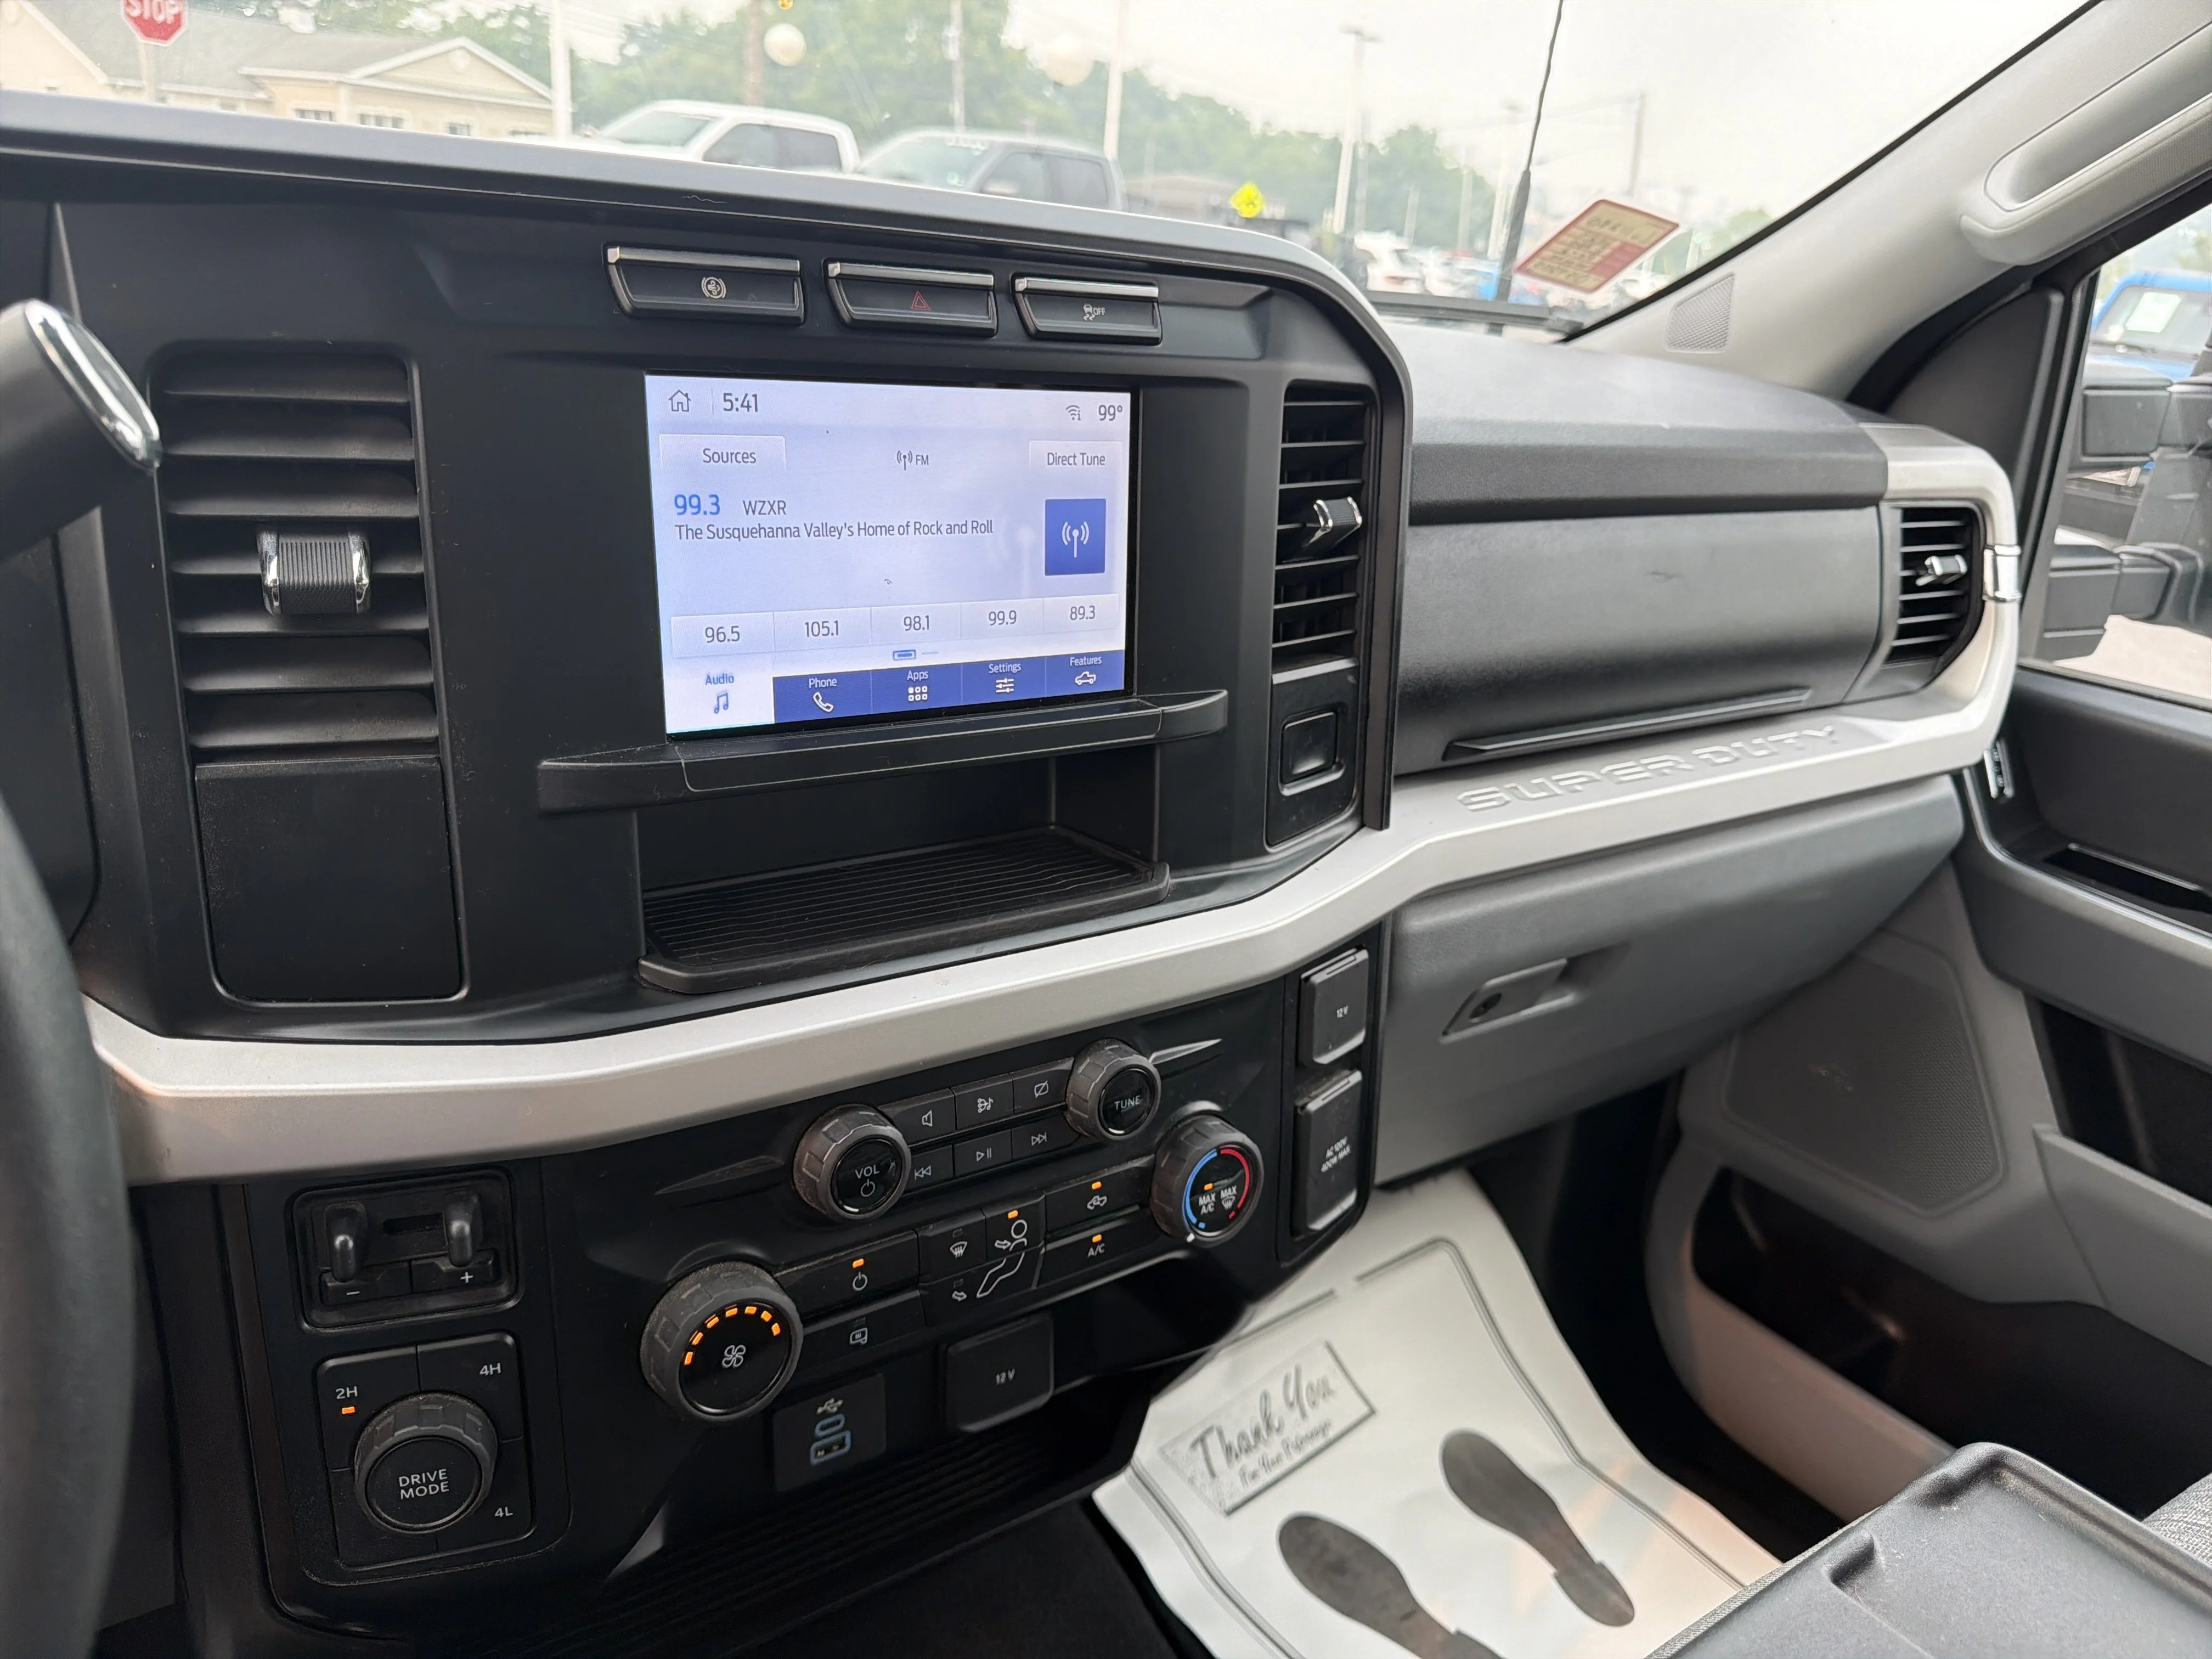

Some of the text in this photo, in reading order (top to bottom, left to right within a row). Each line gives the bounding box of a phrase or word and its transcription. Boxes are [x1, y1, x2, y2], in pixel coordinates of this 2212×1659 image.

[1093, 307, 1106, 316] OFF
[723, 392, 758, 412] 5:41
[702, 448, 757, 464] Sources
[916, 454, 929, 465] FM
[1047, 452, 1105, 466] Direct Tune
[674, 494, 787, 516] 99.3 WZXR
[675, 519, 994, 542] The Susquehanna Valley's Home of Rock and Roll
[988, 610, 1017, 627] 99.9
[1070, 605, 1096, 621] 89.3
[804, 620, 839, 637] 105.1
[904, 615, 930, 631] 98.1
[704, 625, 740, 644] 96.5
[988, 662, 1022, 674] Settings
[1069, 655, 1102, 667] Features
[705, 673, 735, 686] Audio
[907, 669, 929, 681] Apps
[809, 678, 837, 689] Phone
[1457, 725, 1839, 812] SUPER DUTY
[1114, 1095, 1141, 1110] TUNE
[855, 1164, 880, 1179] VOL
[1199, 1192, 1216, 1206] MAX
[1220, 1185, 1237, 1199] MAX
[1200, 1202, 1215, 1216] A/C
[1087, 1243, 1105, 1258] A/C
[479, 1362, 501, 1376] 4H
[335, 1386, 358, 1399] 2H
[1189, 1363, 1336, 1479] Thank You
[399, 1468, 448, 1487] DRIVE
[400, 1481, 449, 1500] MODE
[494, 1506, 514, 1517] 4L
